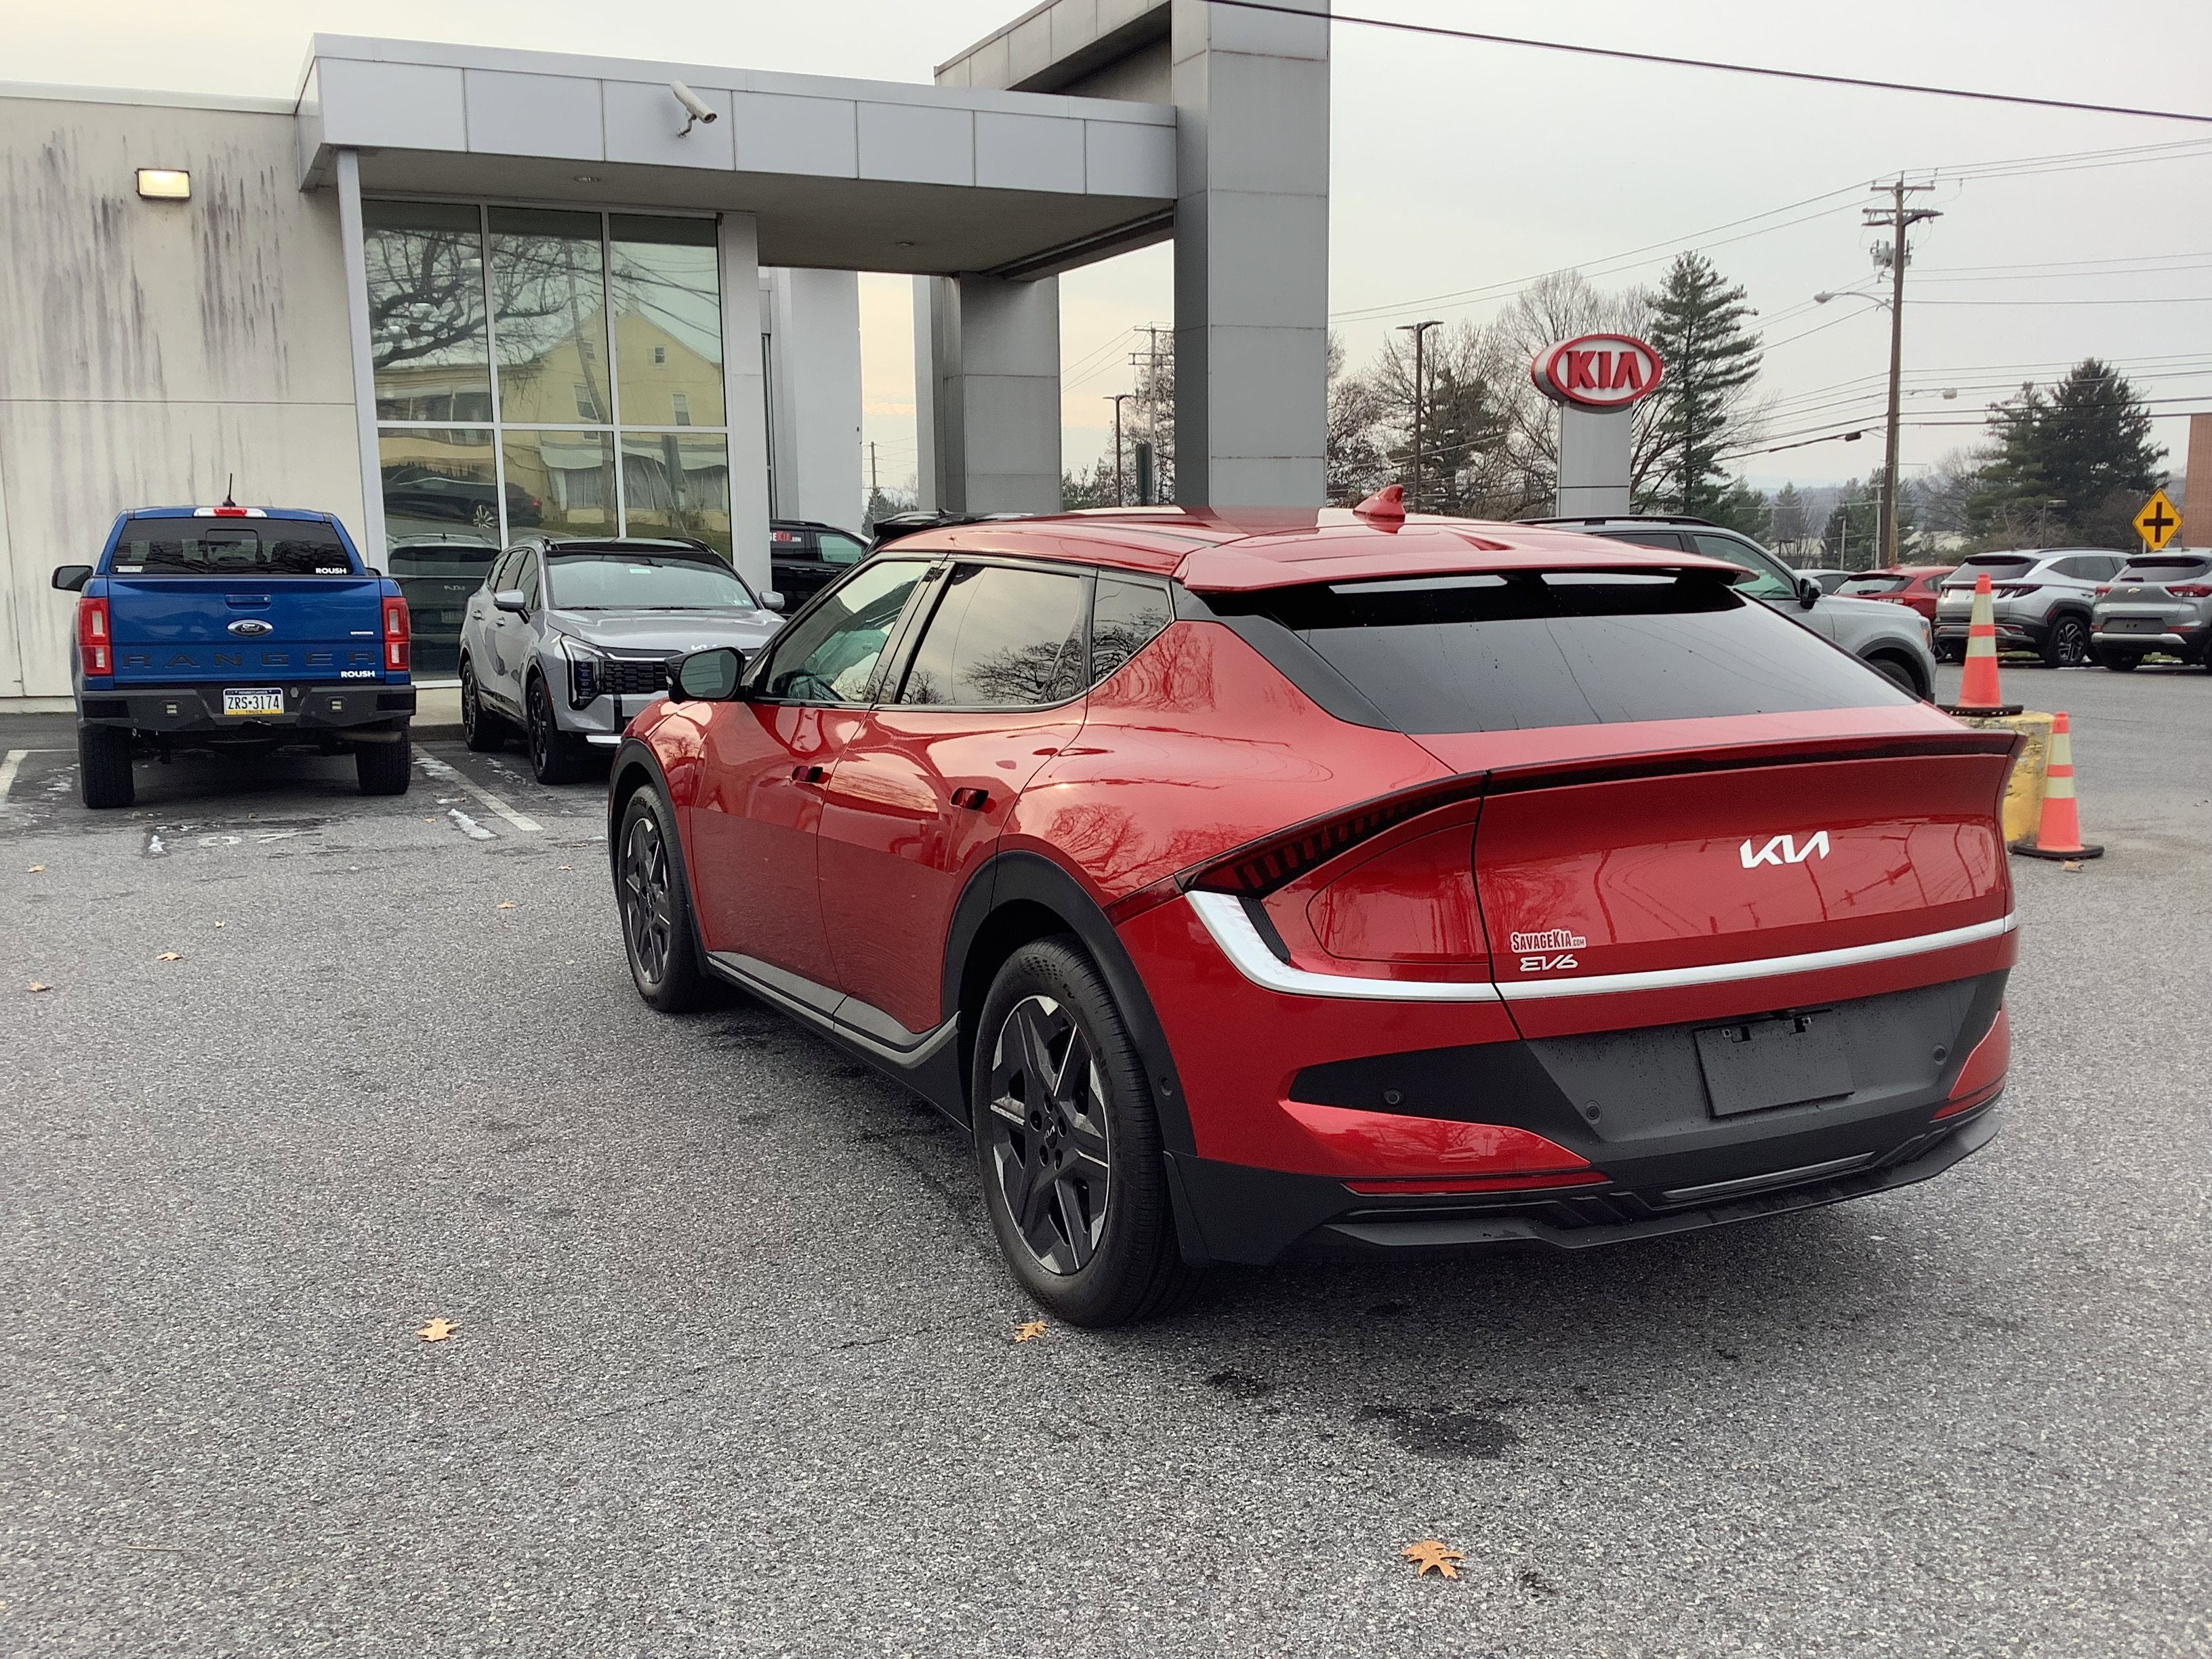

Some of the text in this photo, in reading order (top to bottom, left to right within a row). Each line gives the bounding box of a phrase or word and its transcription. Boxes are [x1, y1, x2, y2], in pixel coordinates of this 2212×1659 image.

[1566, 350, 1643, 390] KIA
[241, 623, 260, 632] Ford
[121, 651, 376, 668] RANGER
[340, 670, 375, 678] ROUSH
[1739, 830, 1830, 869] KIA
[1520, 954, 1578, 971] EV6
